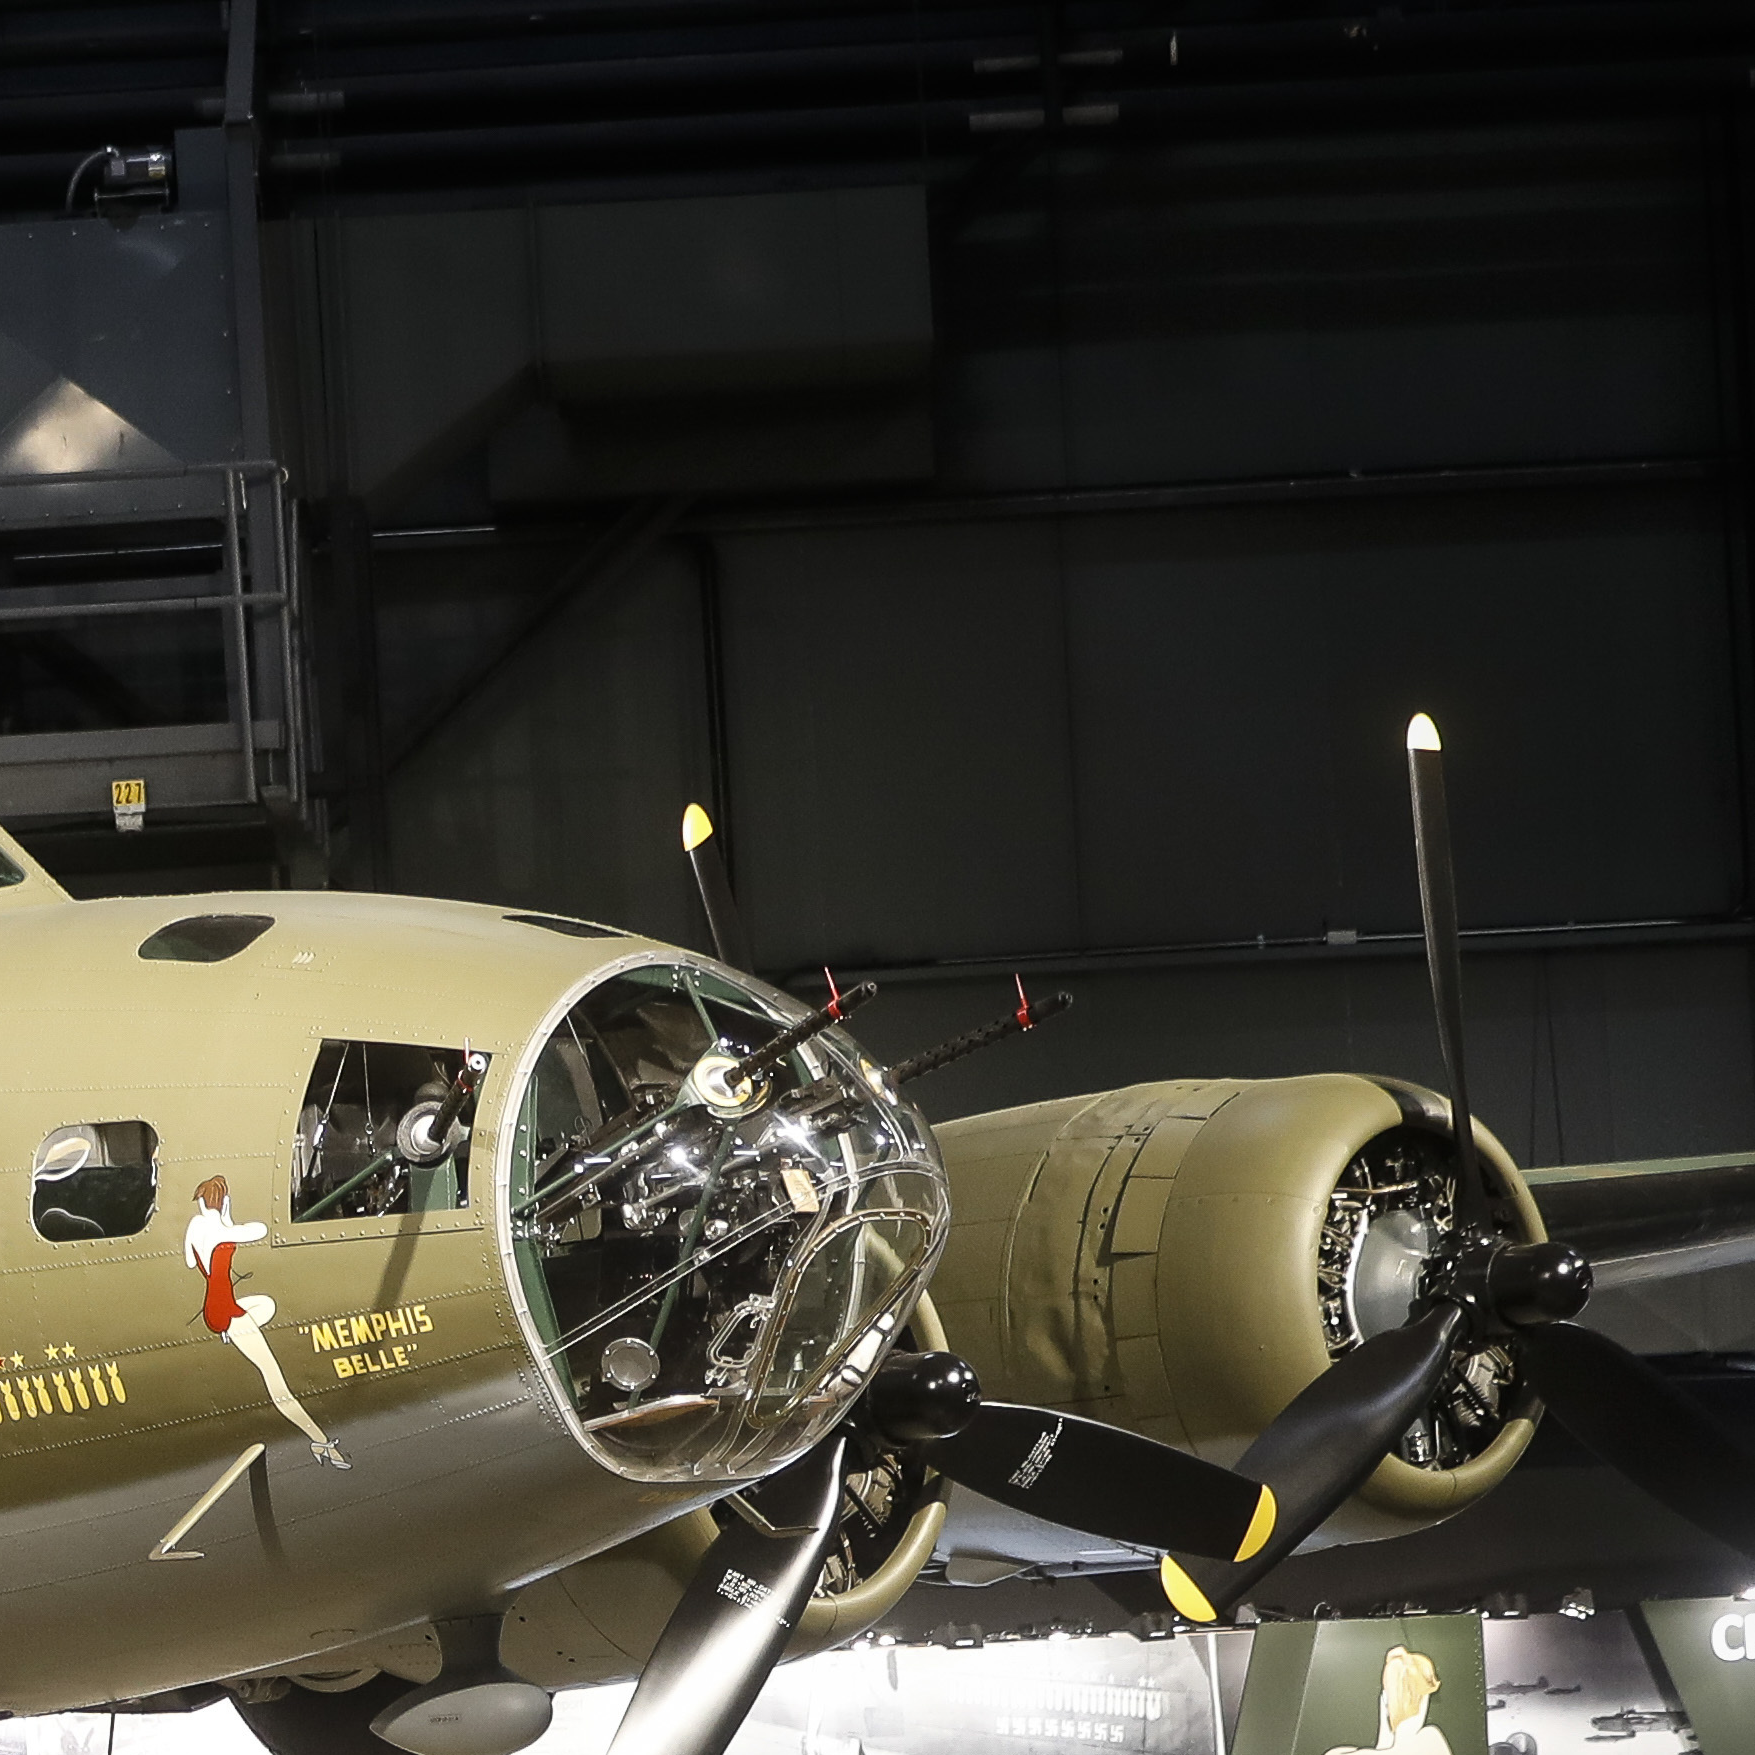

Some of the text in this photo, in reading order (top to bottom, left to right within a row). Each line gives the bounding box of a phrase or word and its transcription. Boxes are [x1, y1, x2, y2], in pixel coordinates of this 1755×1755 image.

[115, 783, 142, 804] 227
[298, 1304, 434, 1353] "MEMPHIS
[332, 1343, 418, 1379] BELLE"
